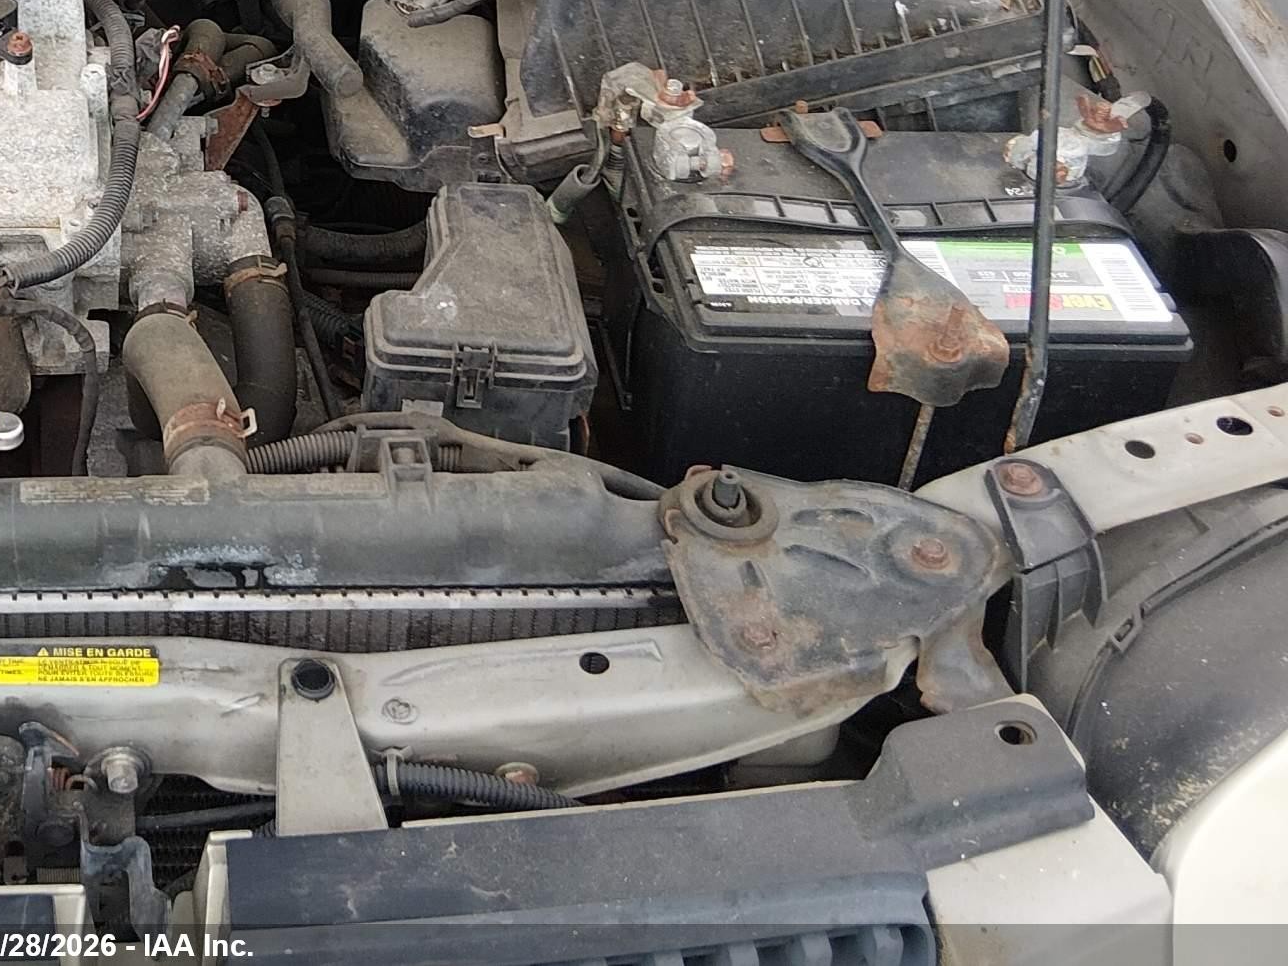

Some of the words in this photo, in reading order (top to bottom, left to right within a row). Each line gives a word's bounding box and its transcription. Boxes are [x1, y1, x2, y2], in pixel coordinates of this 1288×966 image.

[747, 295, 860, 306] DANGER/POISON
[53, 648, 83, 657] MISE
[87, 648, 104, 657] EN
[107, 648, 151, 657] GARDE
